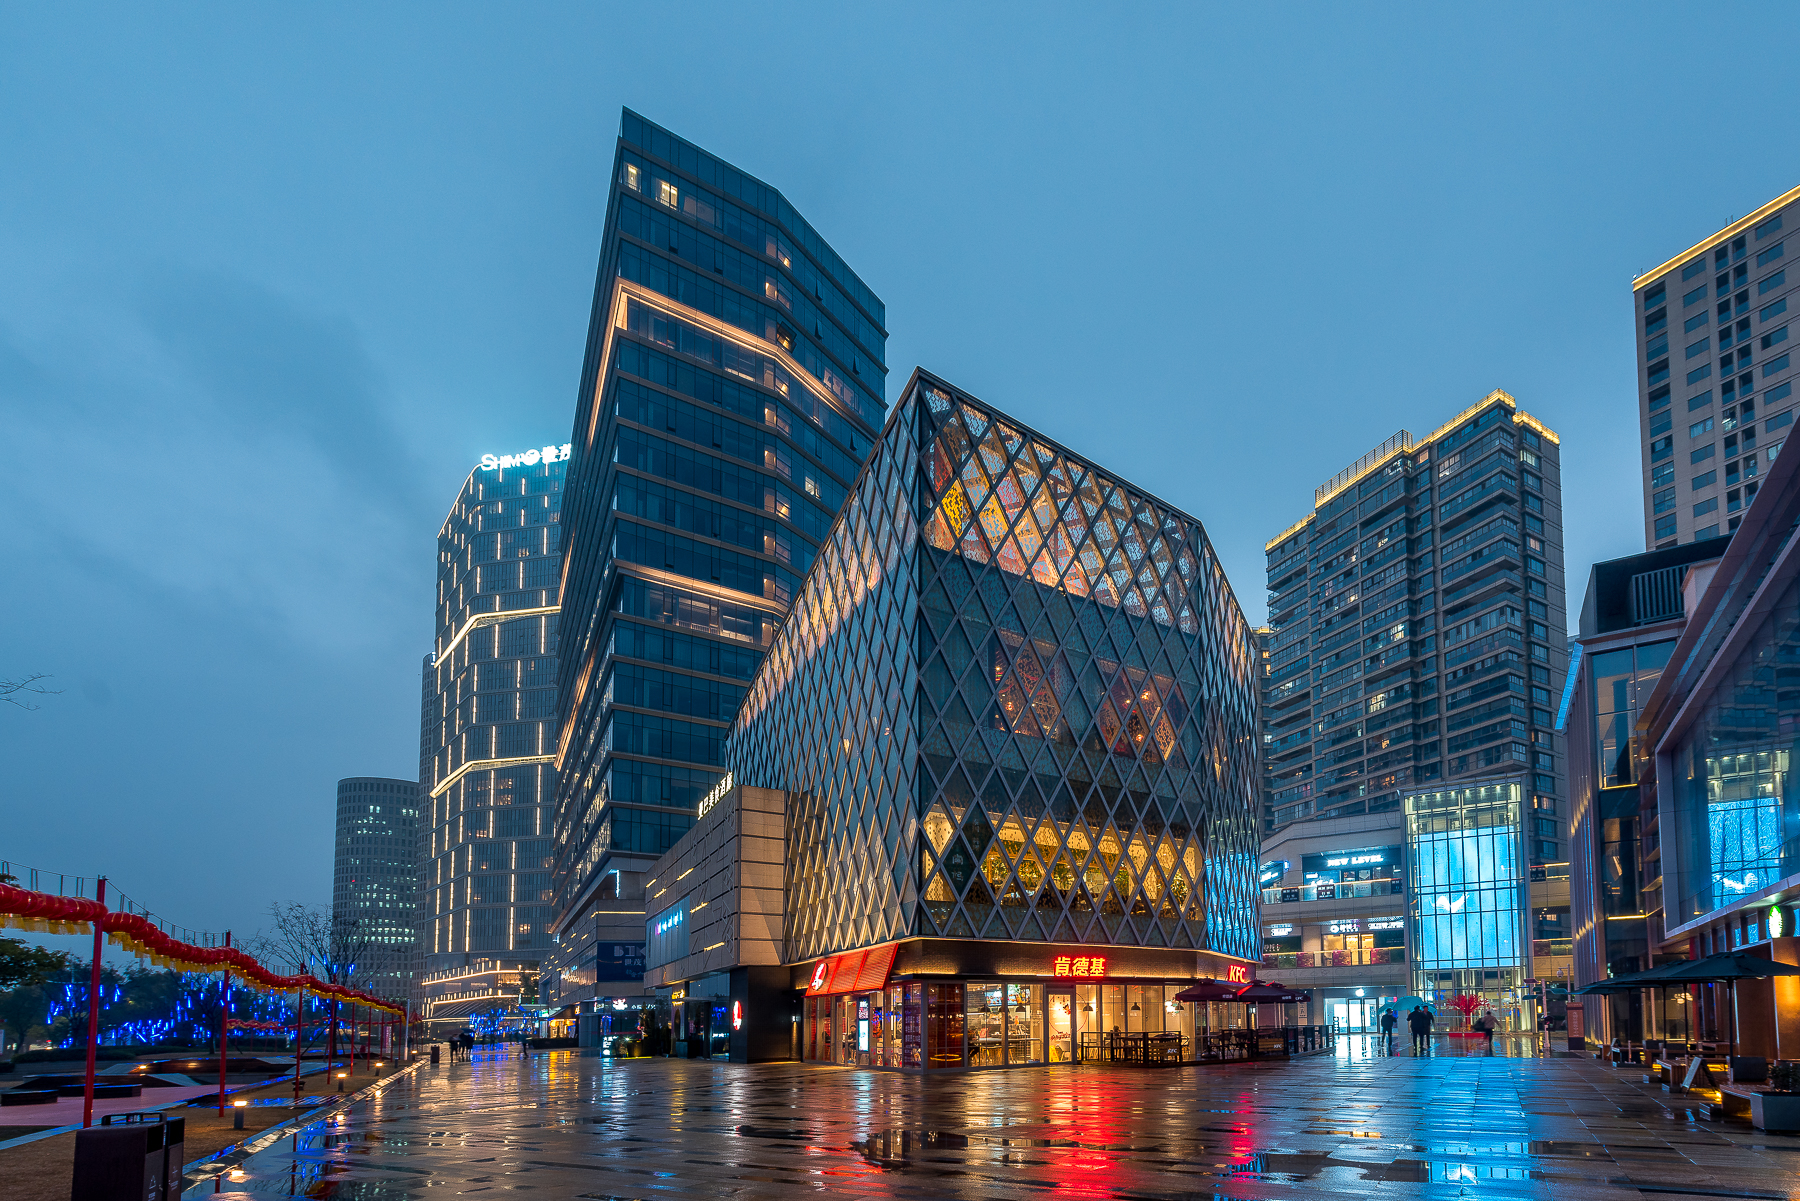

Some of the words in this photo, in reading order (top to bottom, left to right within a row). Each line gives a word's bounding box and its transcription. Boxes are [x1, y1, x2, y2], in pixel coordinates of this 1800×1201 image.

[1327, 857, 1349, 867] NEW
[1351, 854, 1384, 865] LEVEL
[1054, 956, 1106, 977] 肯德基
[1228, 965, 1246, 983] KFC
